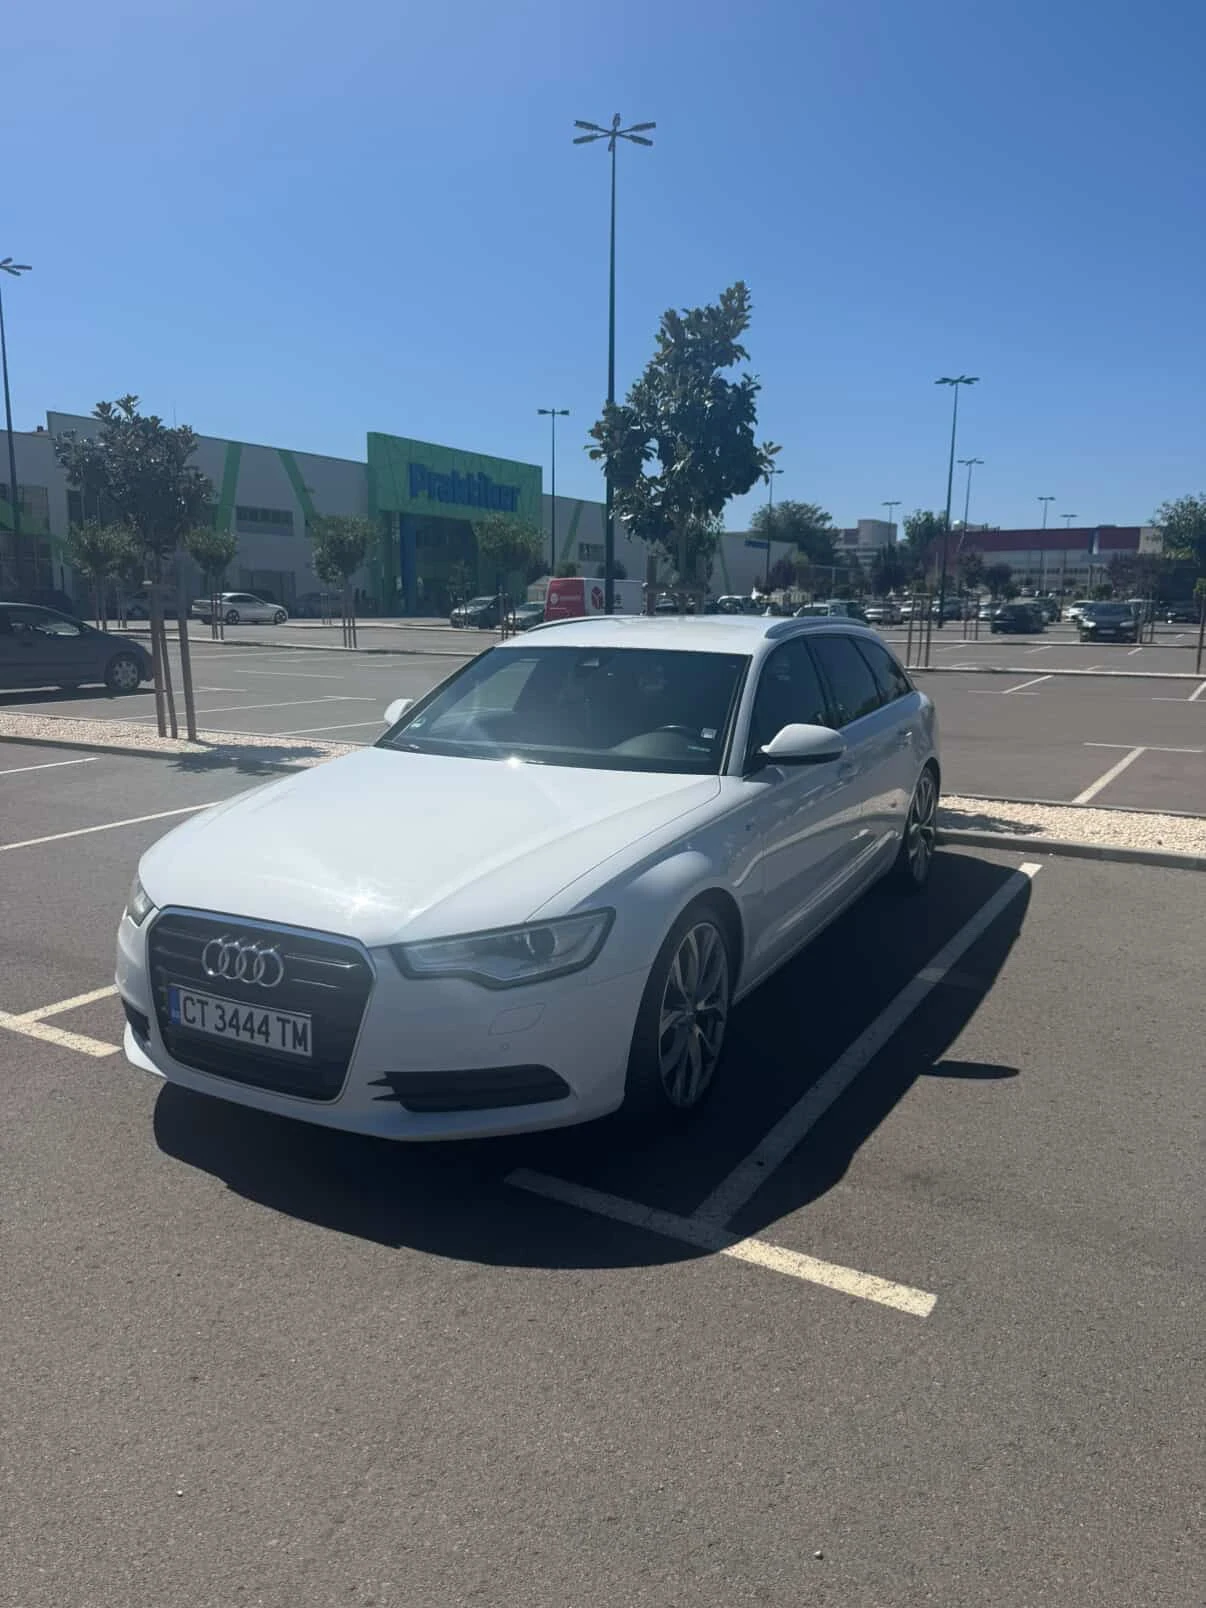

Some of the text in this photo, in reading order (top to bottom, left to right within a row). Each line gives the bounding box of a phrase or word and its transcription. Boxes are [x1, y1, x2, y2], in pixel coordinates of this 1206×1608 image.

[183, 996, 310, 1052] CT 3444 TM
